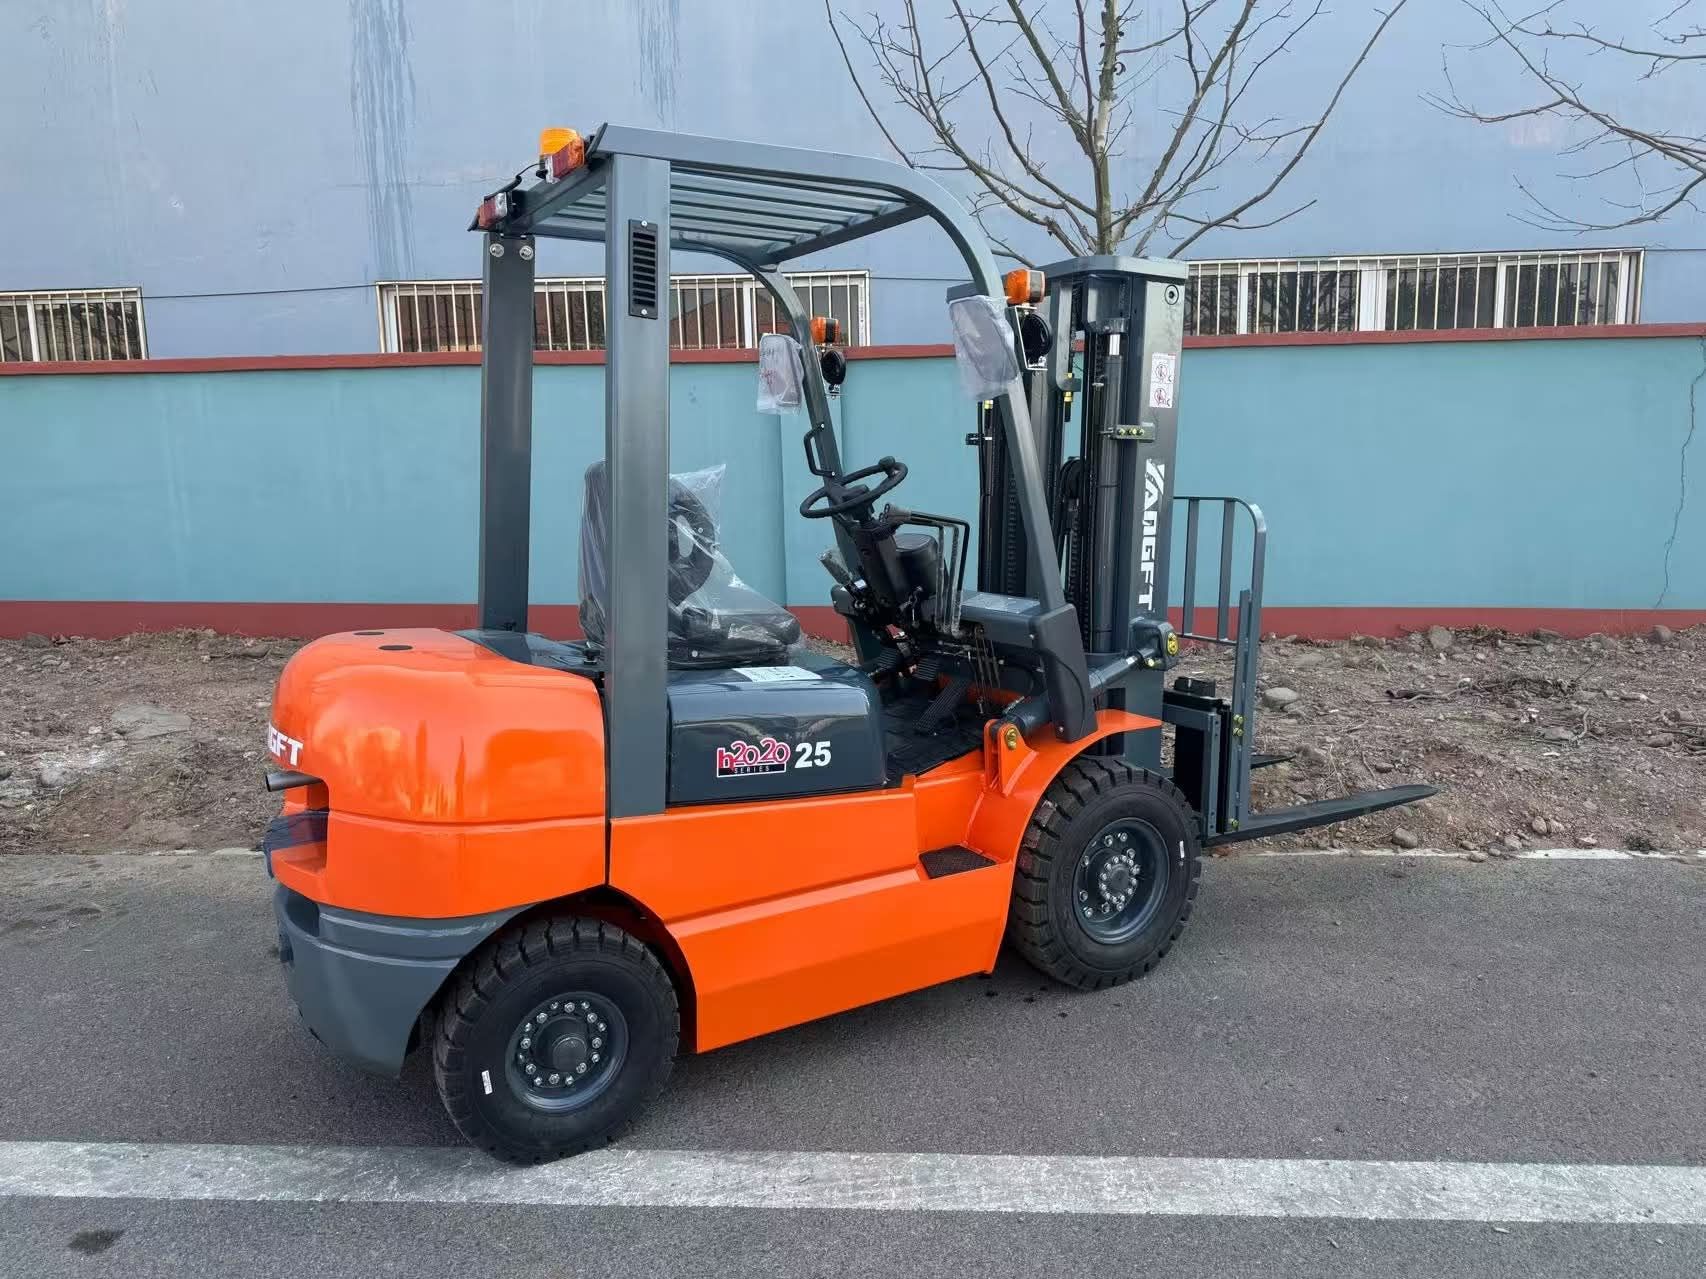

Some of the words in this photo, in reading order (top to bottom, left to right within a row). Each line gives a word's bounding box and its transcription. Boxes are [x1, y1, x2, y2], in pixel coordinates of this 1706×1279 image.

[268, 721, 304, 767] GFT
[794, 740, 832, 769] 25
[734, 765, 770, 774] SERIES
